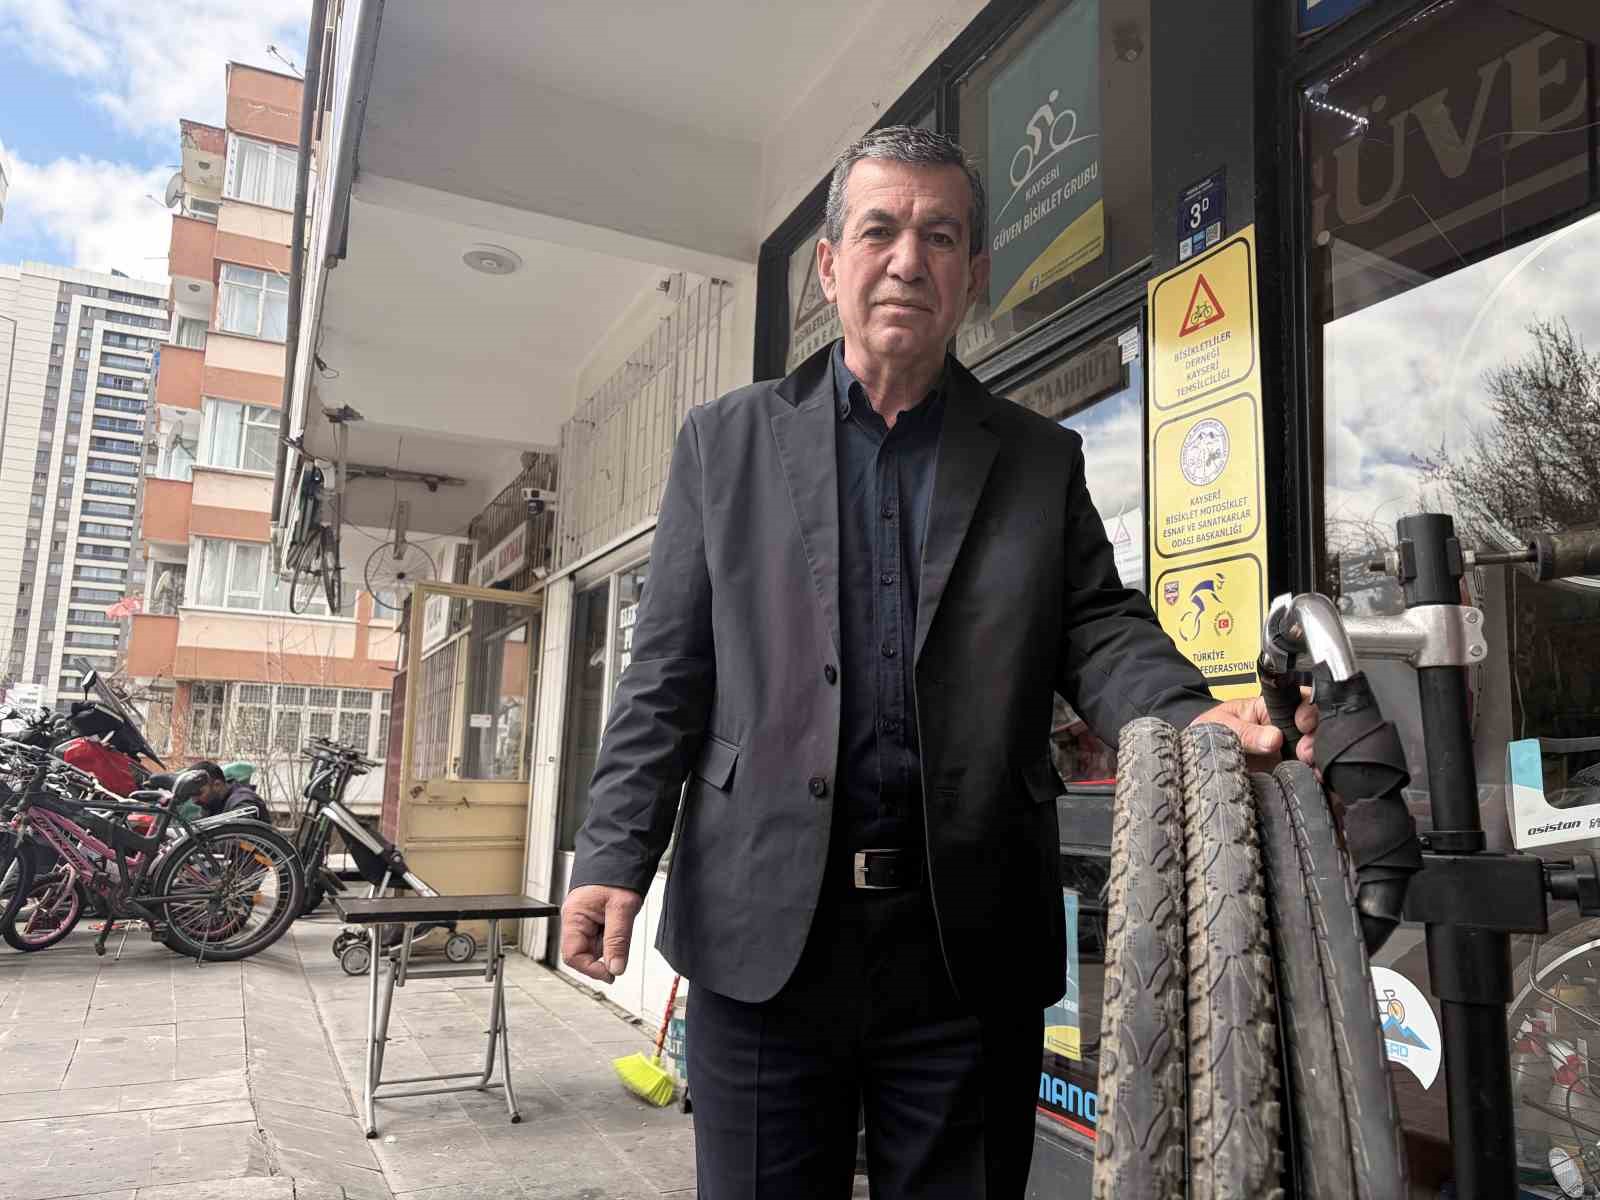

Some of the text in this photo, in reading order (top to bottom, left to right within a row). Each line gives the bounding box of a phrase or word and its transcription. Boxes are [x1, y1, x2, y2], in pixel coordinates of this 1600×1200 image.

[1312, 30, 1587, 240] ÜVE
[993, 160, 1098, 251] GÜVEN BİSİKLET GRUBU
[1190, 488, 1221, 506] KAYSERİ
[1163, 526, 1186, 538] ESNAF
[1187, 521, 1196, 531] VE
[1193, 649, 1225, 662] TÜRKİYE
[1200, 660, 1255, 674] FEDERASYONU
[1527, 819, 1581, 836] asistan
